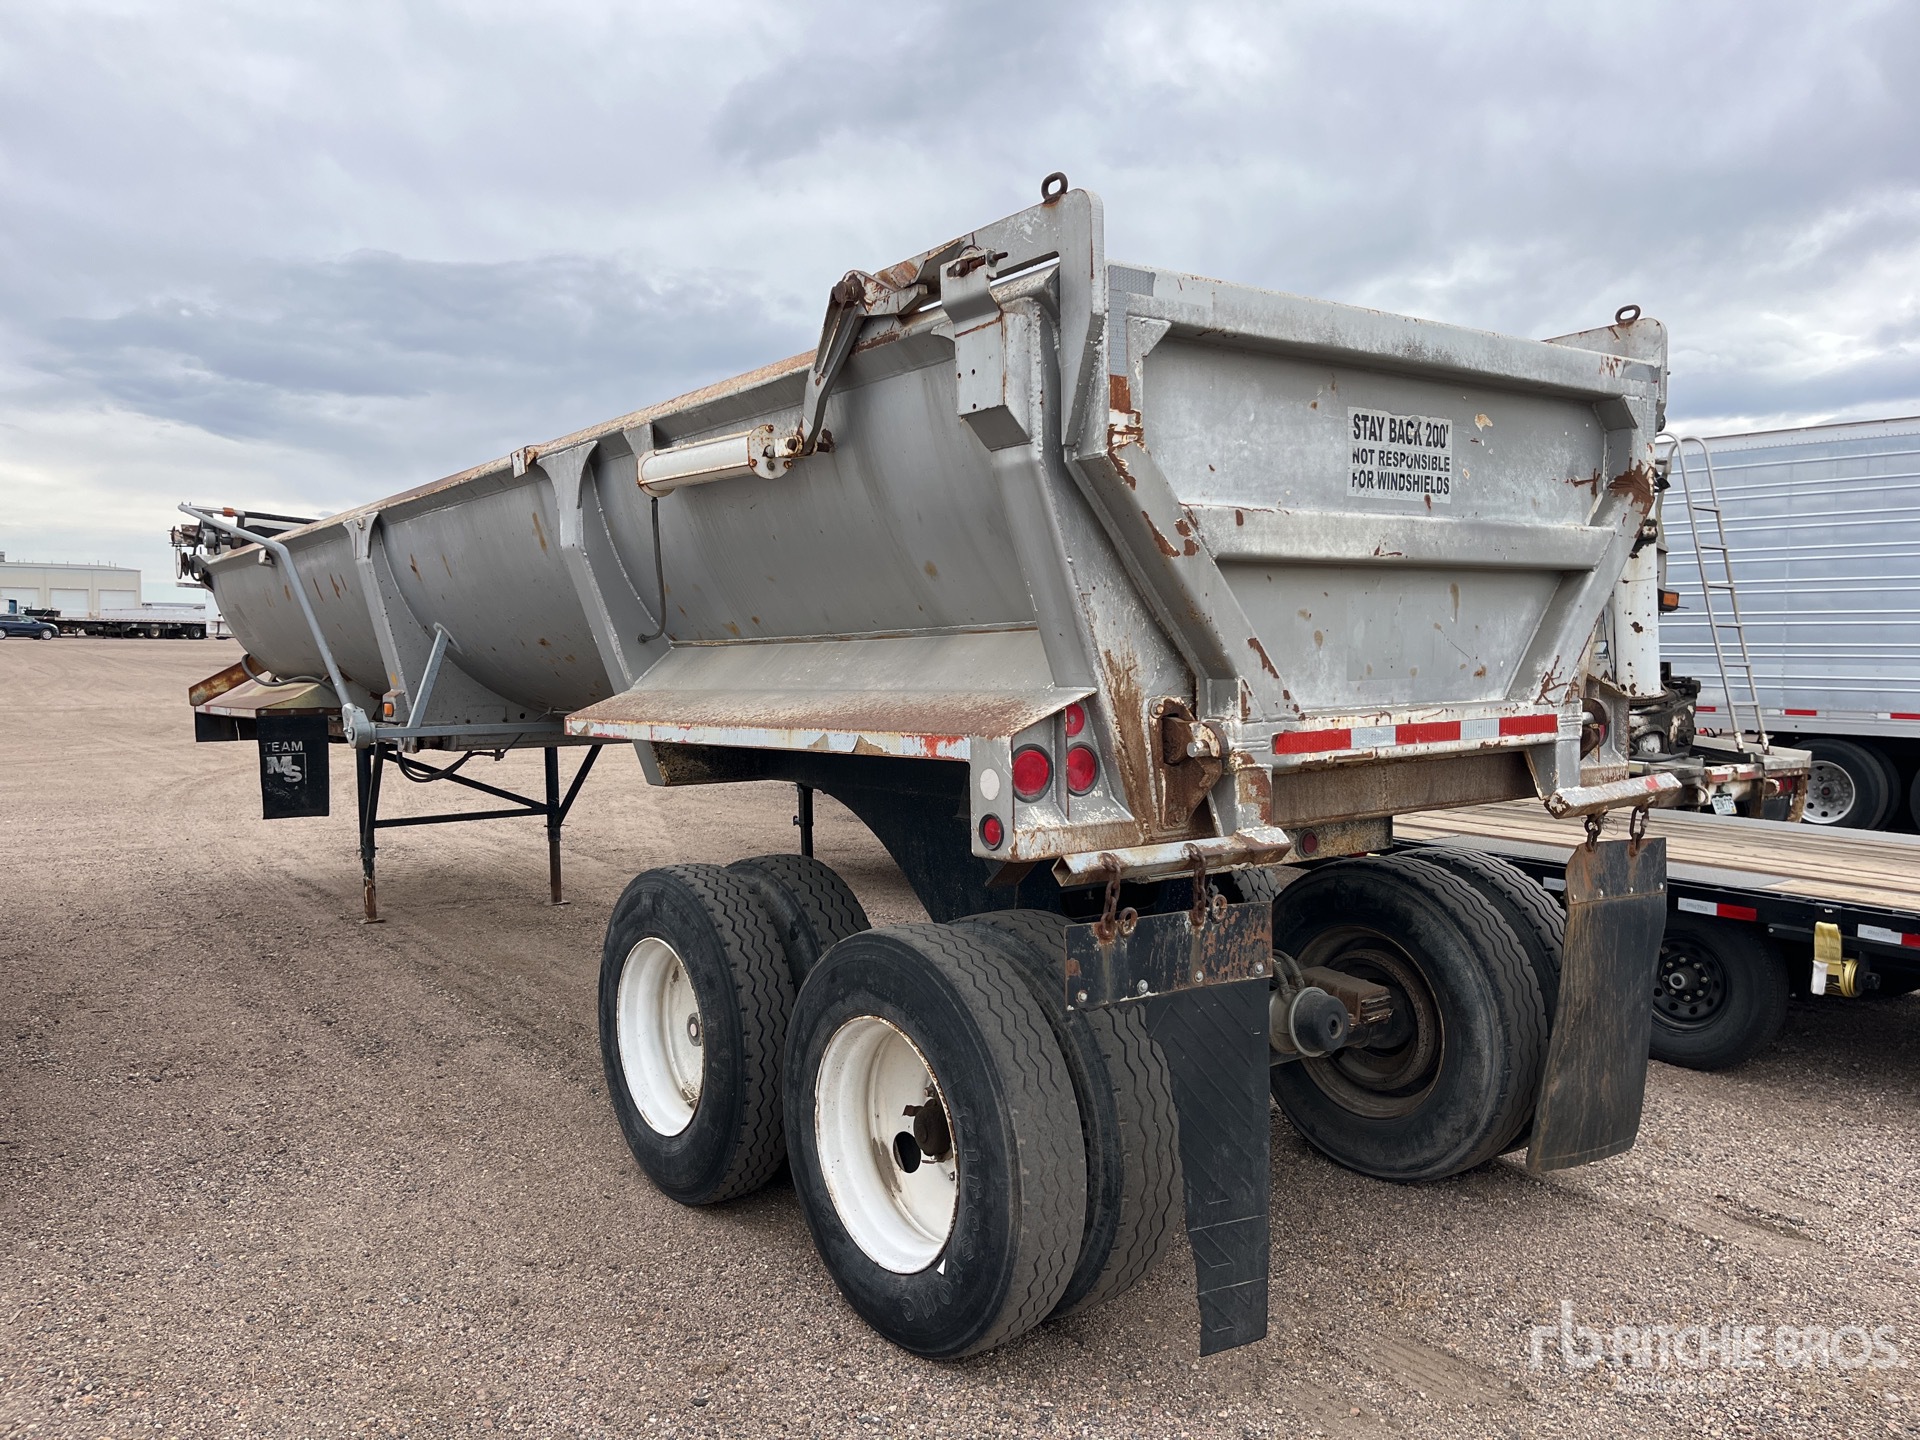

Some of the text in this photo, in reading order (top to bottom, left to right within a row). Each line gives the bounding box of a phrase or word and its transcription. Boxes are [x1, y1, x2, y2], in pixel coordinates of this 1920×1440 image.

[1353, 413, 1449, 449] STAY BACK 200'
[1352, 448, 1450, 472] NOT RESPONSIBLE
[1352, 470, 1450, 494] FOR WINDSHIELDS
[263, 741, 303, 752] TEAM
